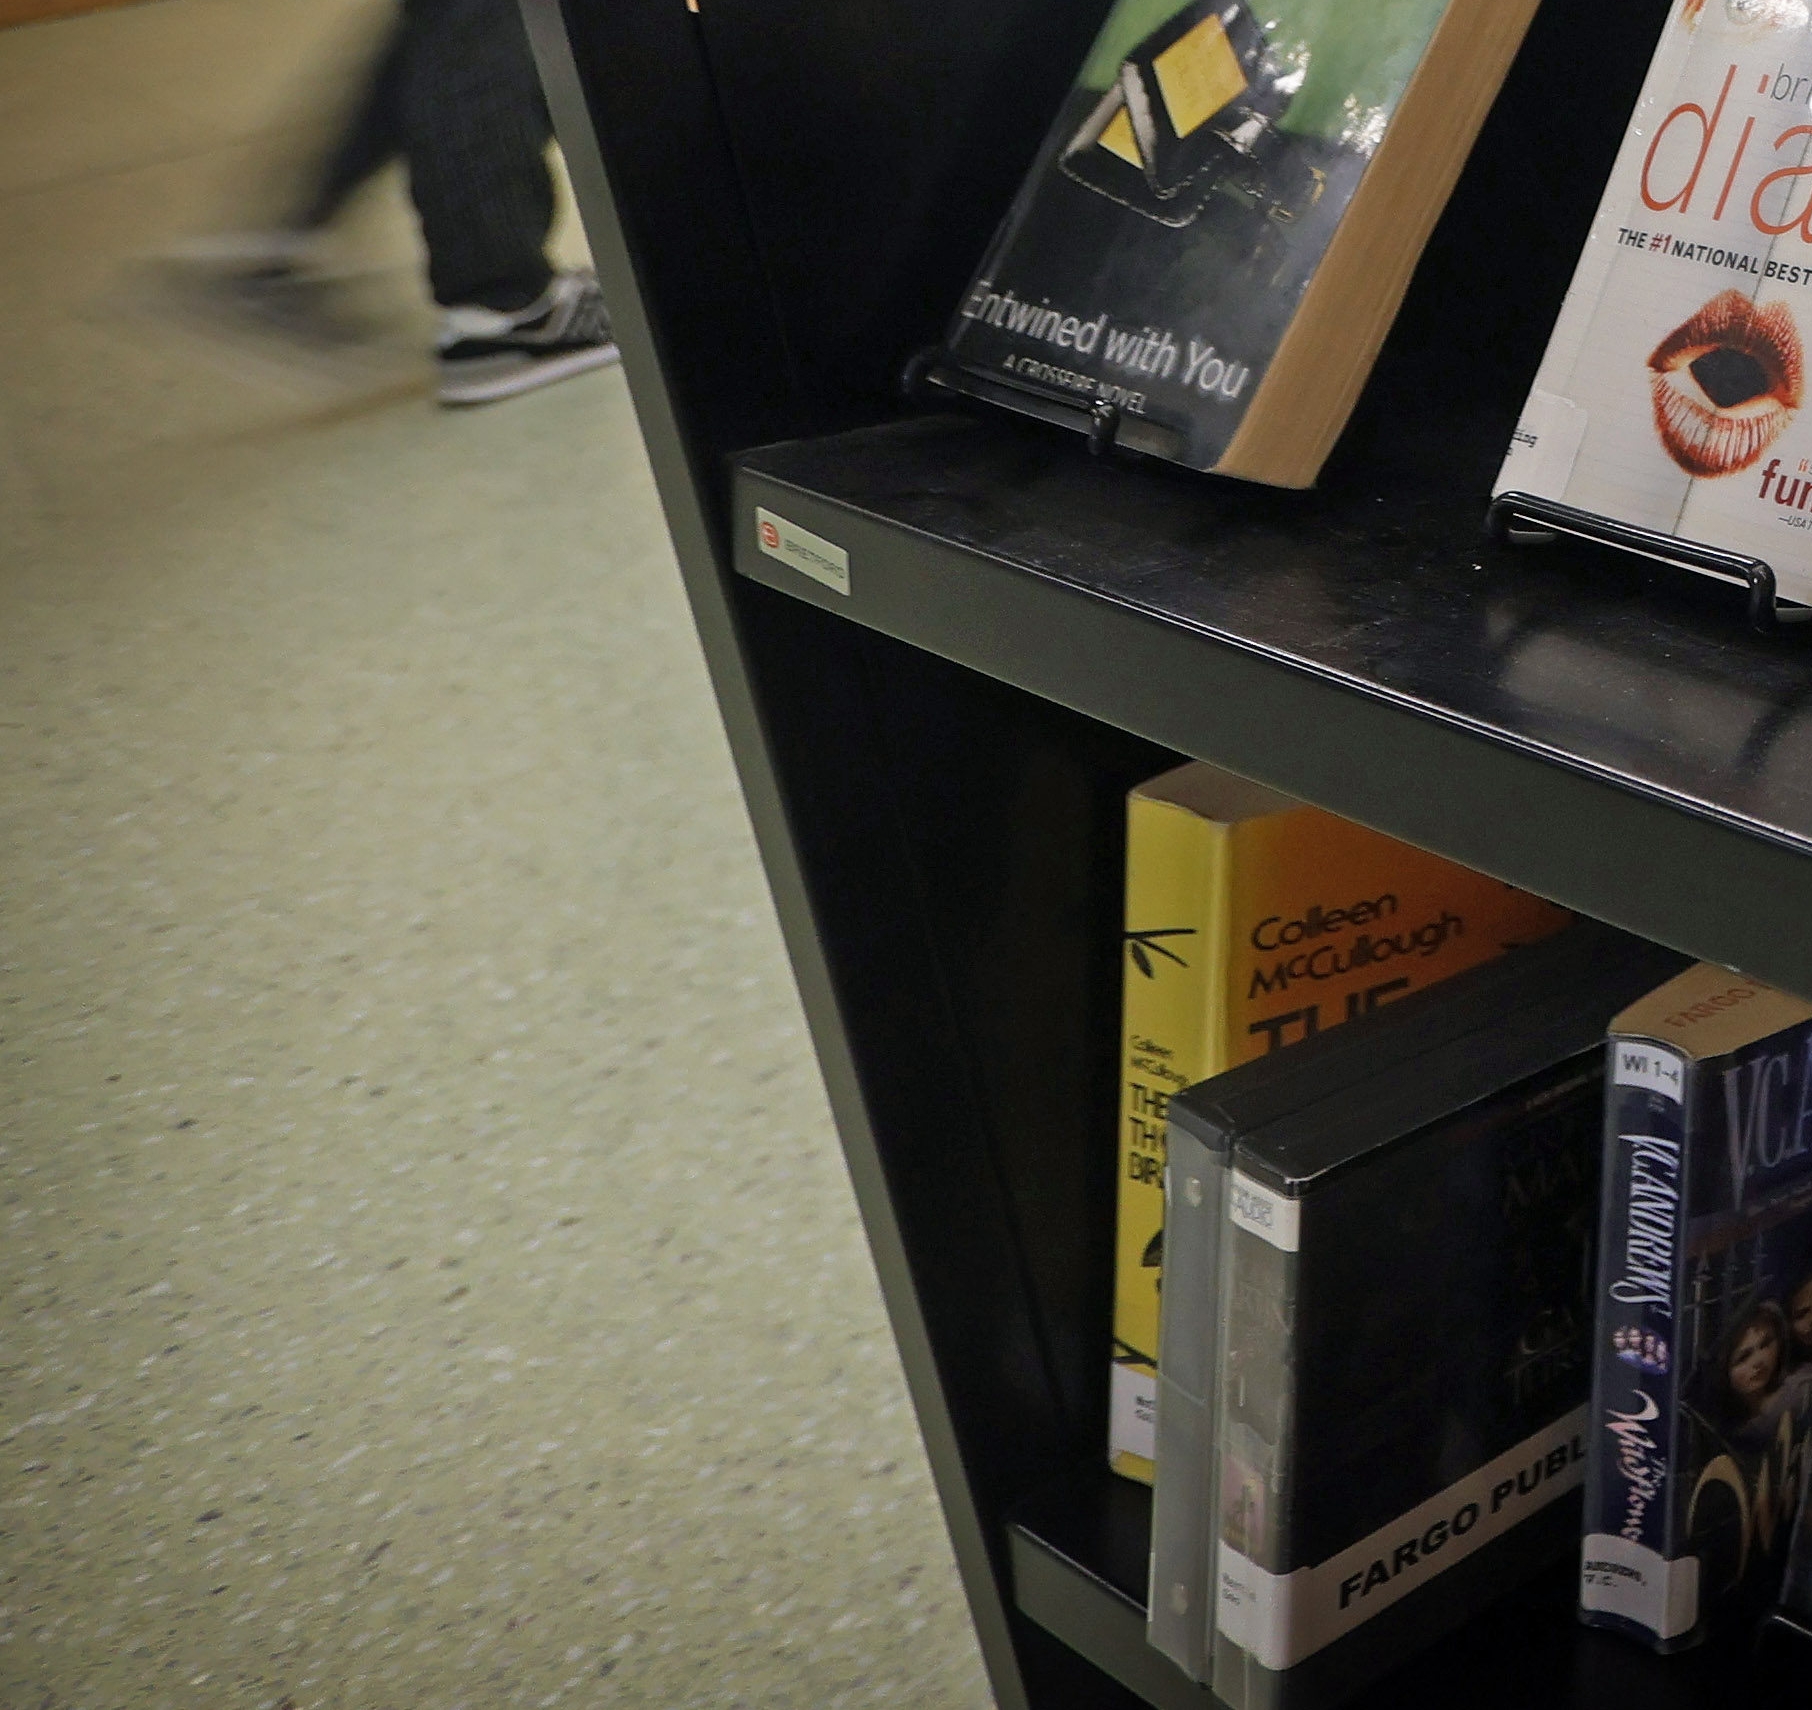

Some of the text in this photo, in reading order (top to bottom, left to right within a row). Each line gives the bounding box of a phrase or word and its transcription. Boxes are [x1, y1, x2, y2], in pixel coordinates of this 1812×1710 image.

[1617, 227, 1649, 250] THE
[1649, 232, 1672, 255] #1
[1672, 240, 1759, 275] NATIONAL
[962, 278, 1250, 400] Entwined with You
[1248, 910, 1466, 1000] McCullough
[1253, 892, 1398, 951] Colleen
[1623, 1053, 1648, 1073] WI
[1339, 1434, 1586, 1611] FARGO PUBL
